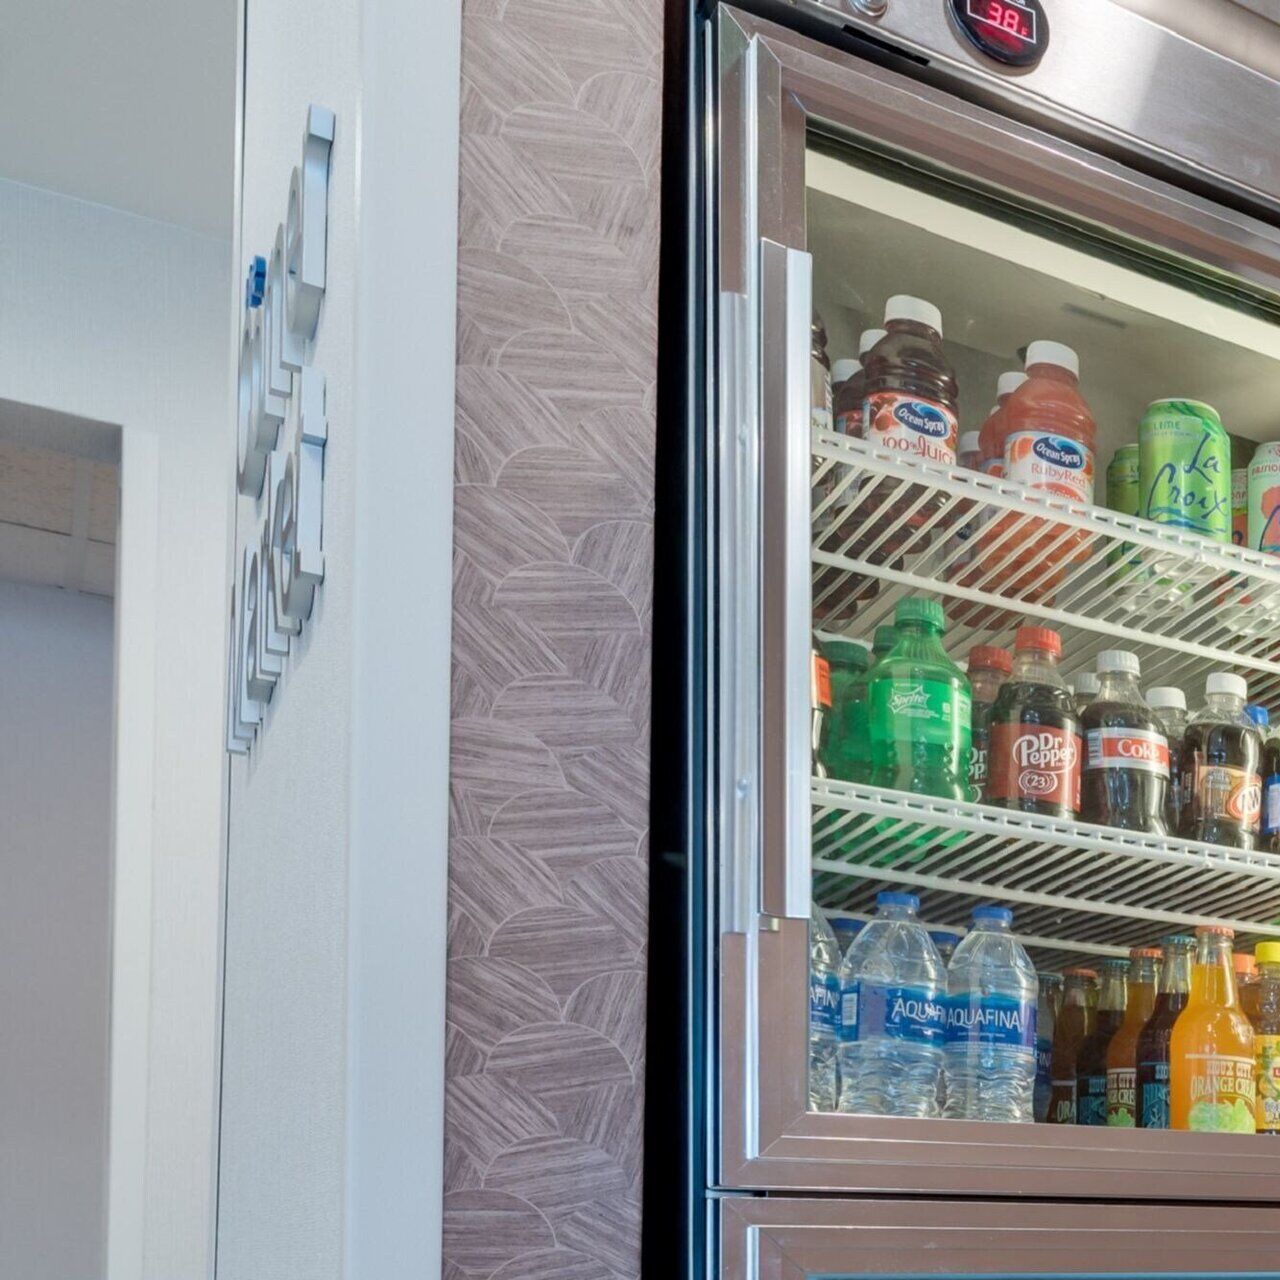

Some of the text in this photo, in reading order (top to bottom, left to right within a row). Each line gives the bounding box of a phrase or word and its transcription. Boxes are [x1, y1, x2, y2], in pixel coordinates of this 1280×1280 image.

[898, 407, 945, 435] Ocean Spray
[1036, 442, 1081, 466] Ocean Spray
[1183, 432, 1221, 485] La
[1147, 462, 1228, 521] Croix
[1019, 734, 1075, 767] Pepper
[1038, 733, 1063, 751] Dr
[1117, 739, 1160, 759] Coke
[1029, 775, 1046, 788] 23
[947, 1008, 1022, 1034] AQUAFINA
